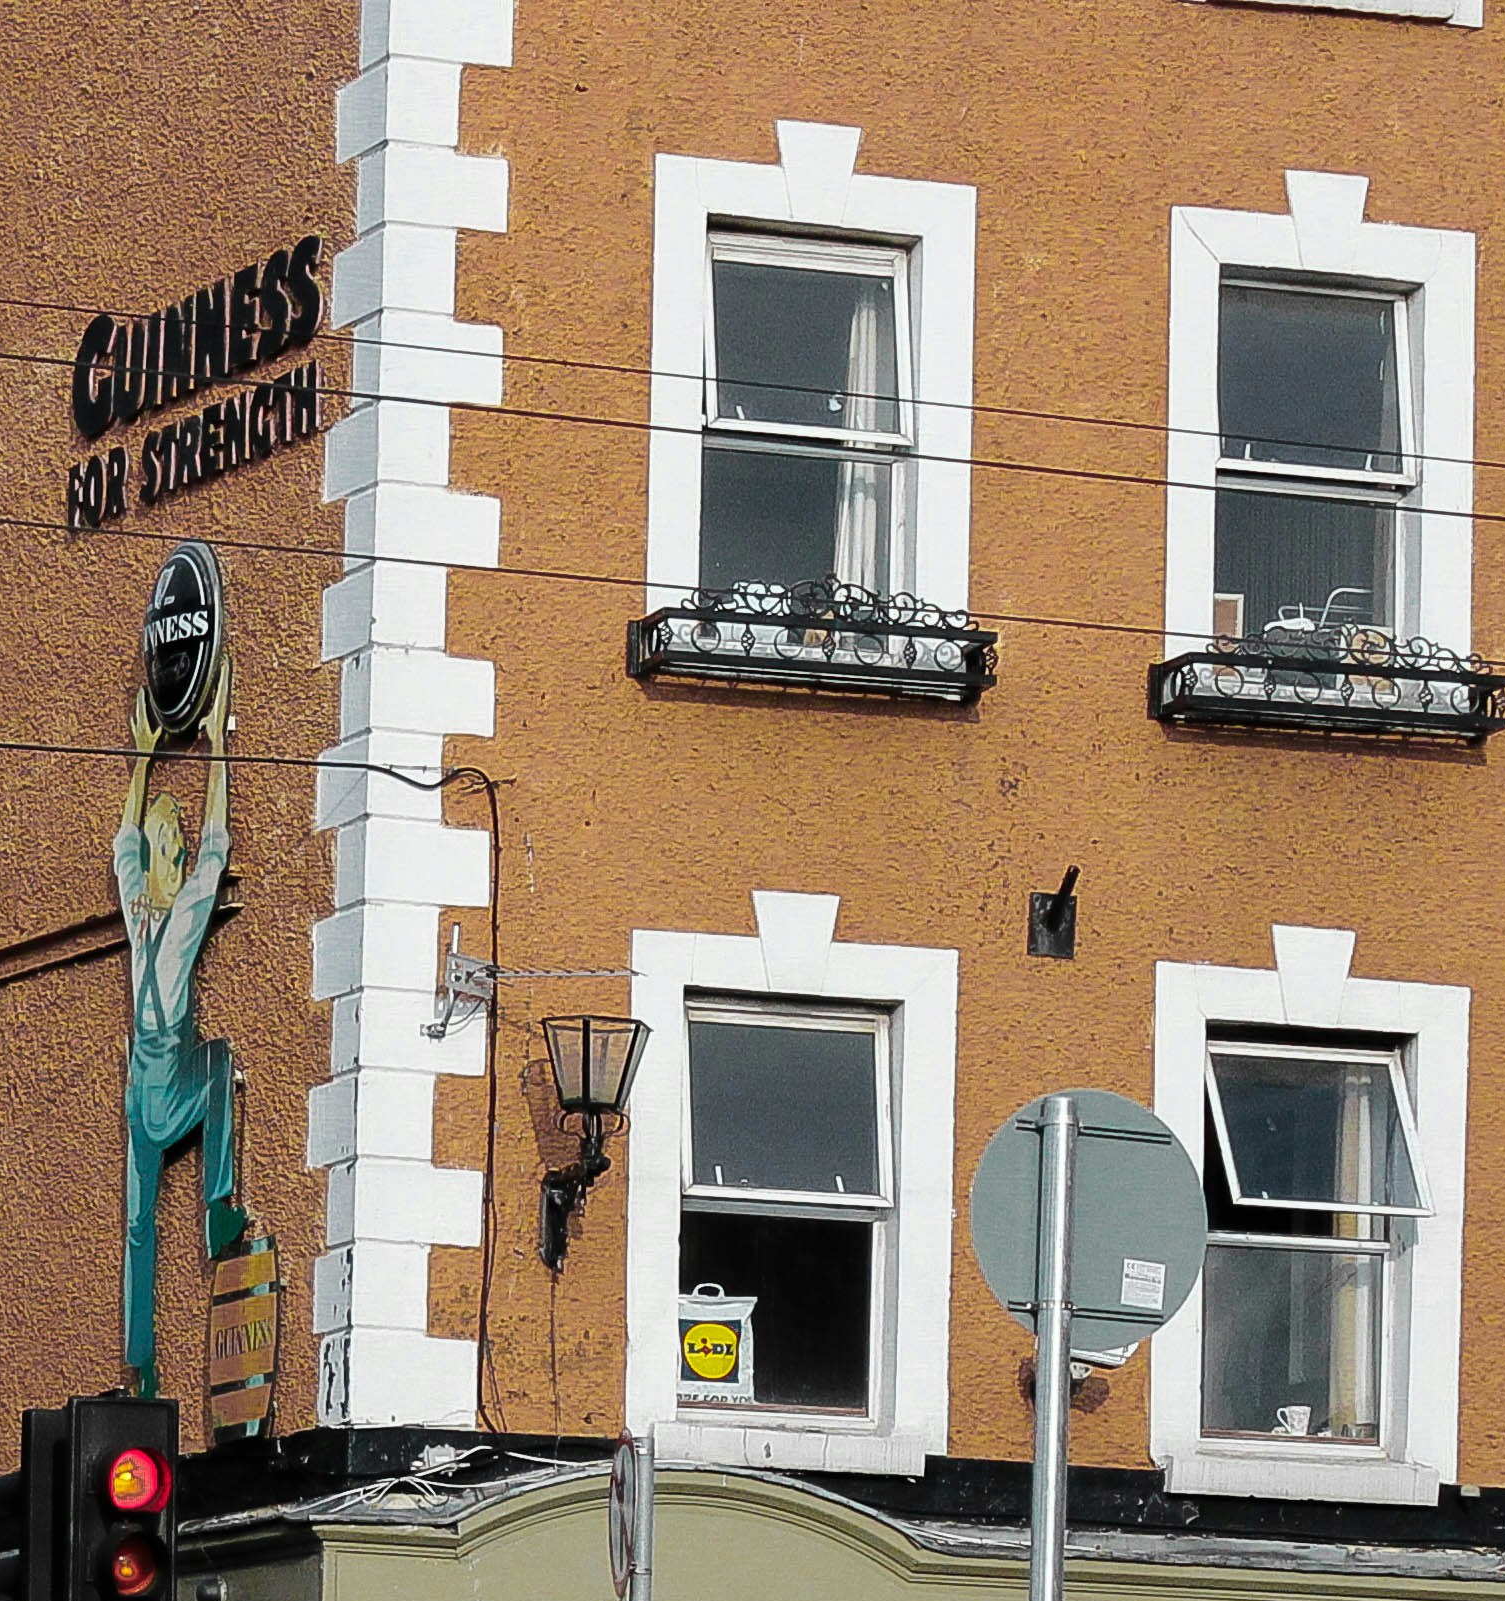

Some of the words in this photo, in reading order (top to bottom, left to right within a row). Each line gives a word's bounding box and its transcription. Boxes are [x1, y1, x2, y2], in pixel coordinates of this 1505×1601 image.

[72, 235, 325, 440] GUINNESS
[67, 446, 131, 530] FOR
[139, 359, 323, 506] STRENGTH
[144, 610, 210, 656] NNESS
